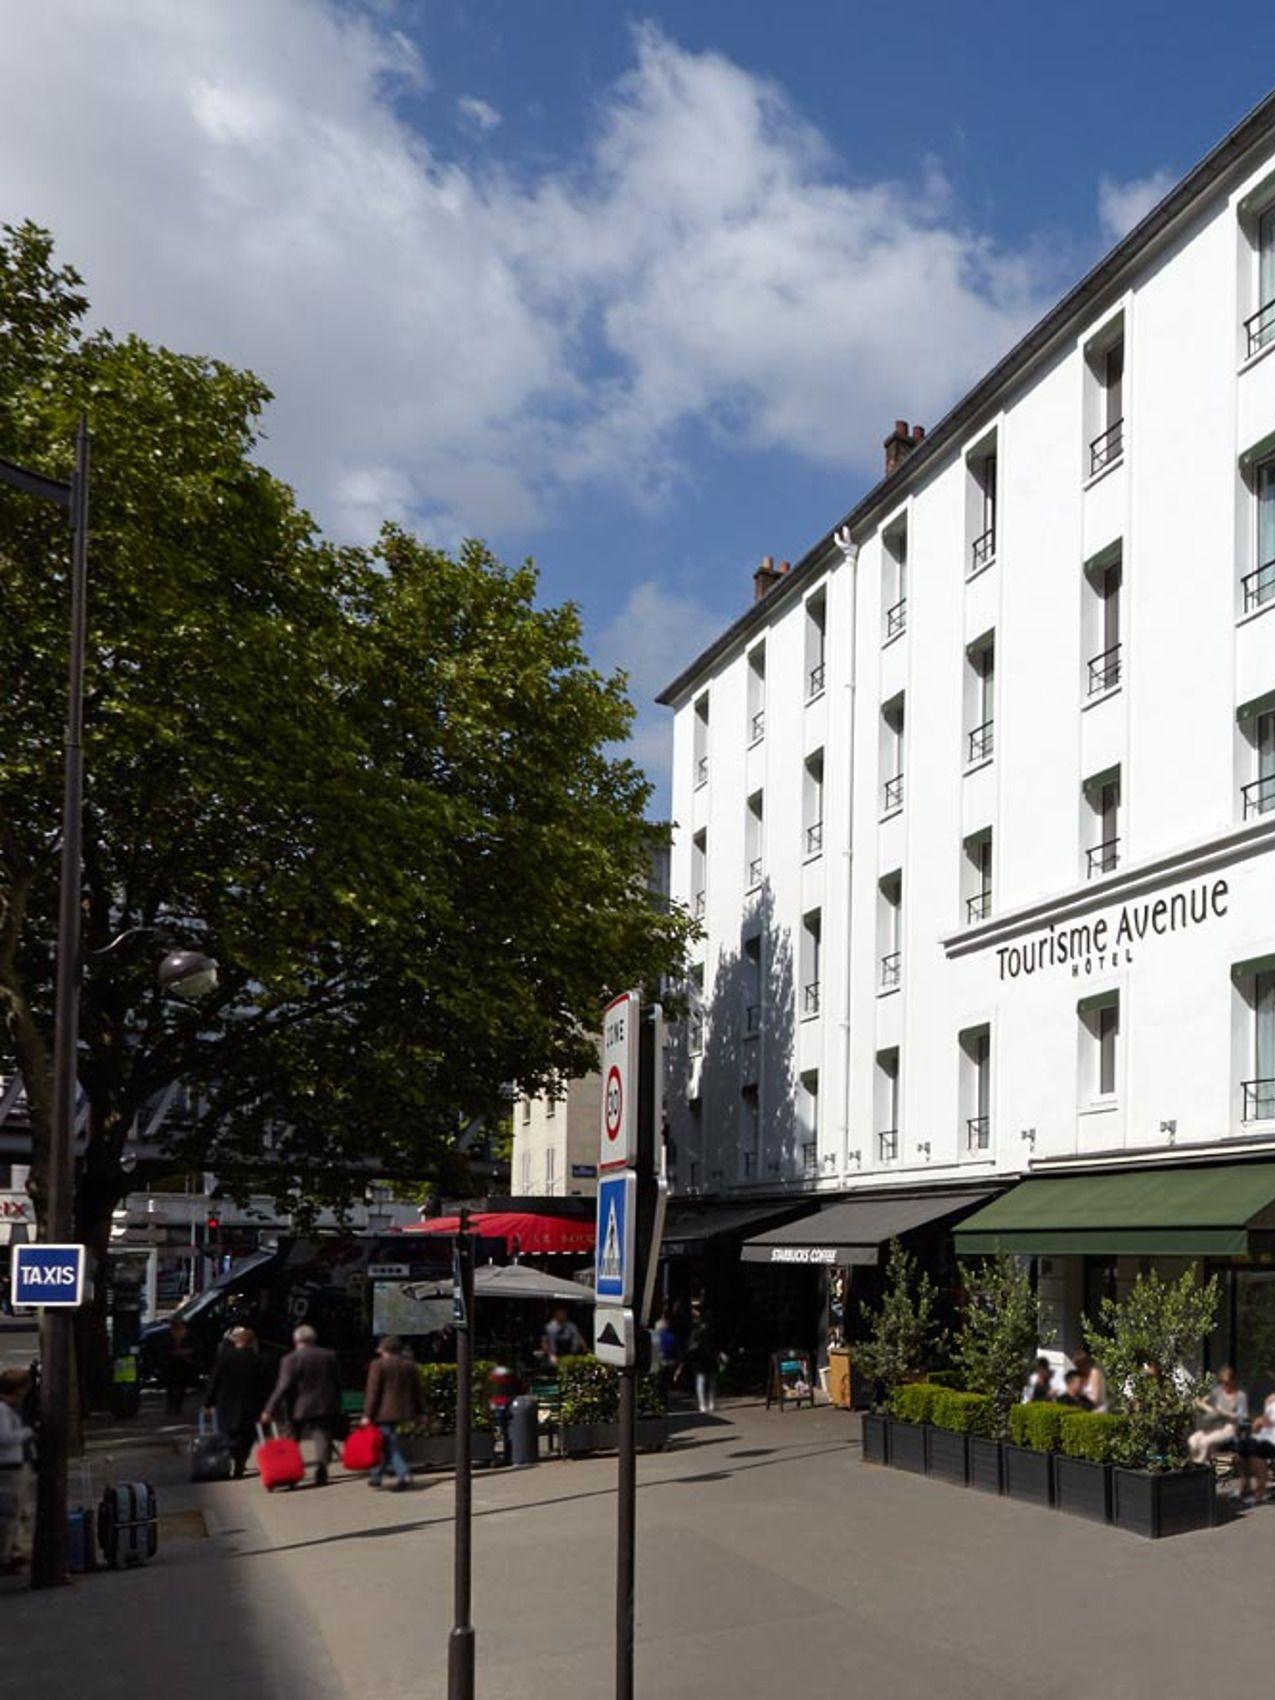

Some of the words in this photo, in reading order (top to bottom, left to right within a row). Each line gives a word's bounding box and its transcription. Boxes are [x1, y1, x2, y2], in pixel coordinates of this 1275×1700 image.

[996, 919, 1108, 981] Tourisme
[1116, 879, 1229, 945] Avenue
[1071, 949, 1133, 977] HÔTEL
[20, 1266, 76, 1285] TAXIS
